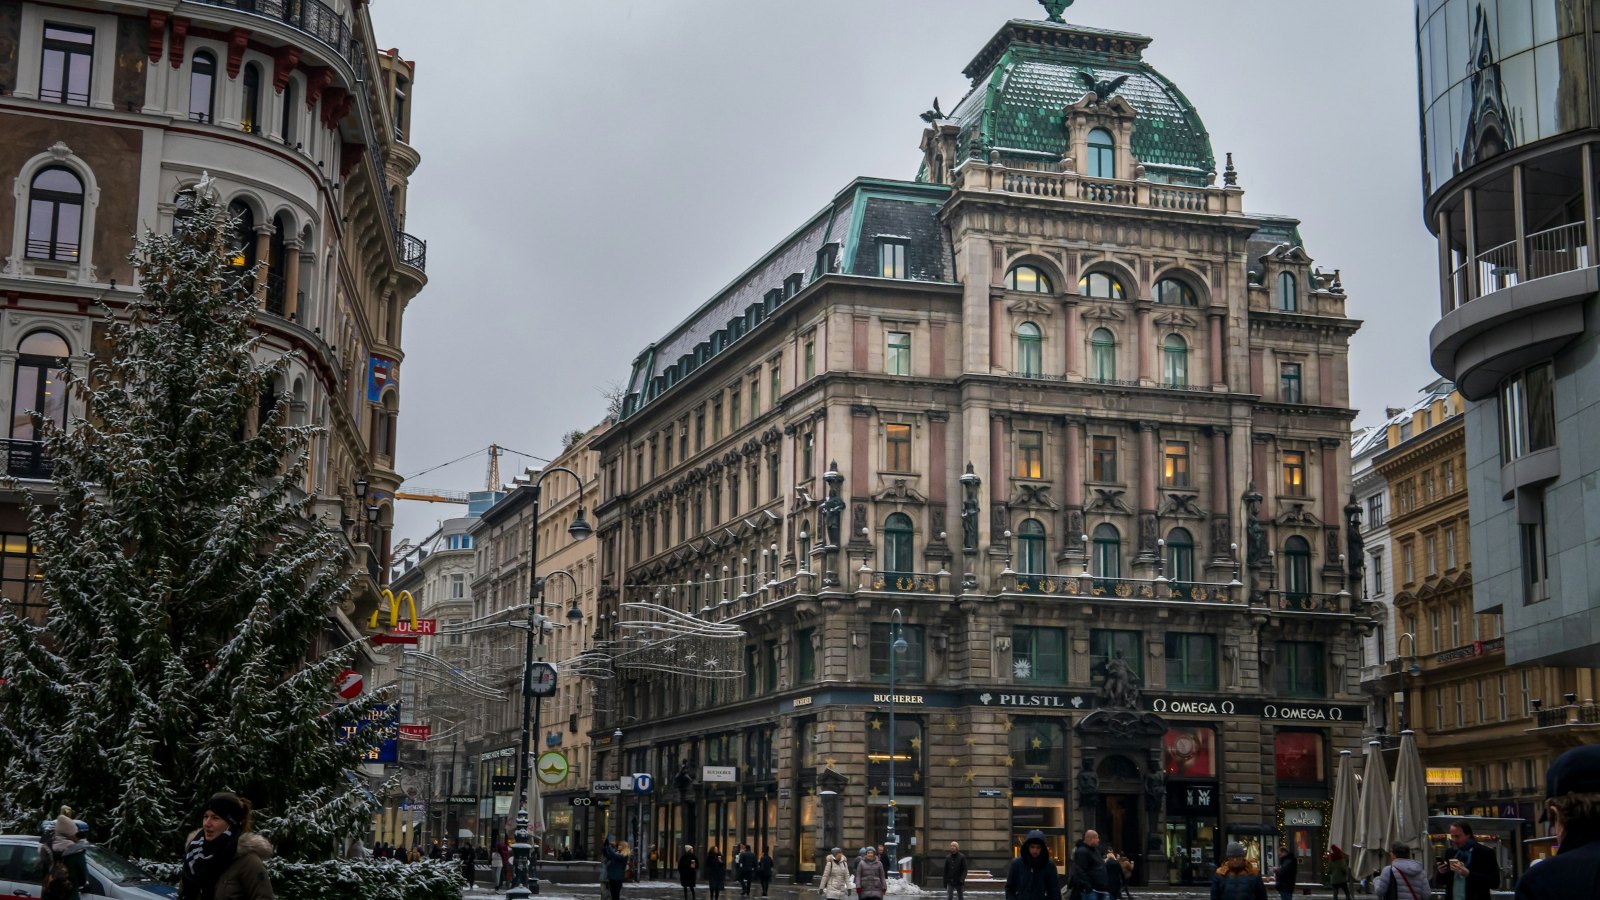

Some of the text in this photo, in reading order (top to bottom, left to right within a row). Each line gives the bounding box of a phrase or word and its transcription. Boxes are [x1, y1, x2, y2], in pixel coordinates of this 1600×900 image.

[394, 621, 431, 633] UBER
[793, 696, 812, 707] BUCHERER
[873, 694, 924, 705] BUCHERER
[999, 694, 1064, 707] PILSTL
[1170, 701, 1217, 714] OMEGA
[1280, 707, 1325, 720] OMEGA
[638, 779, 650, 790] U
